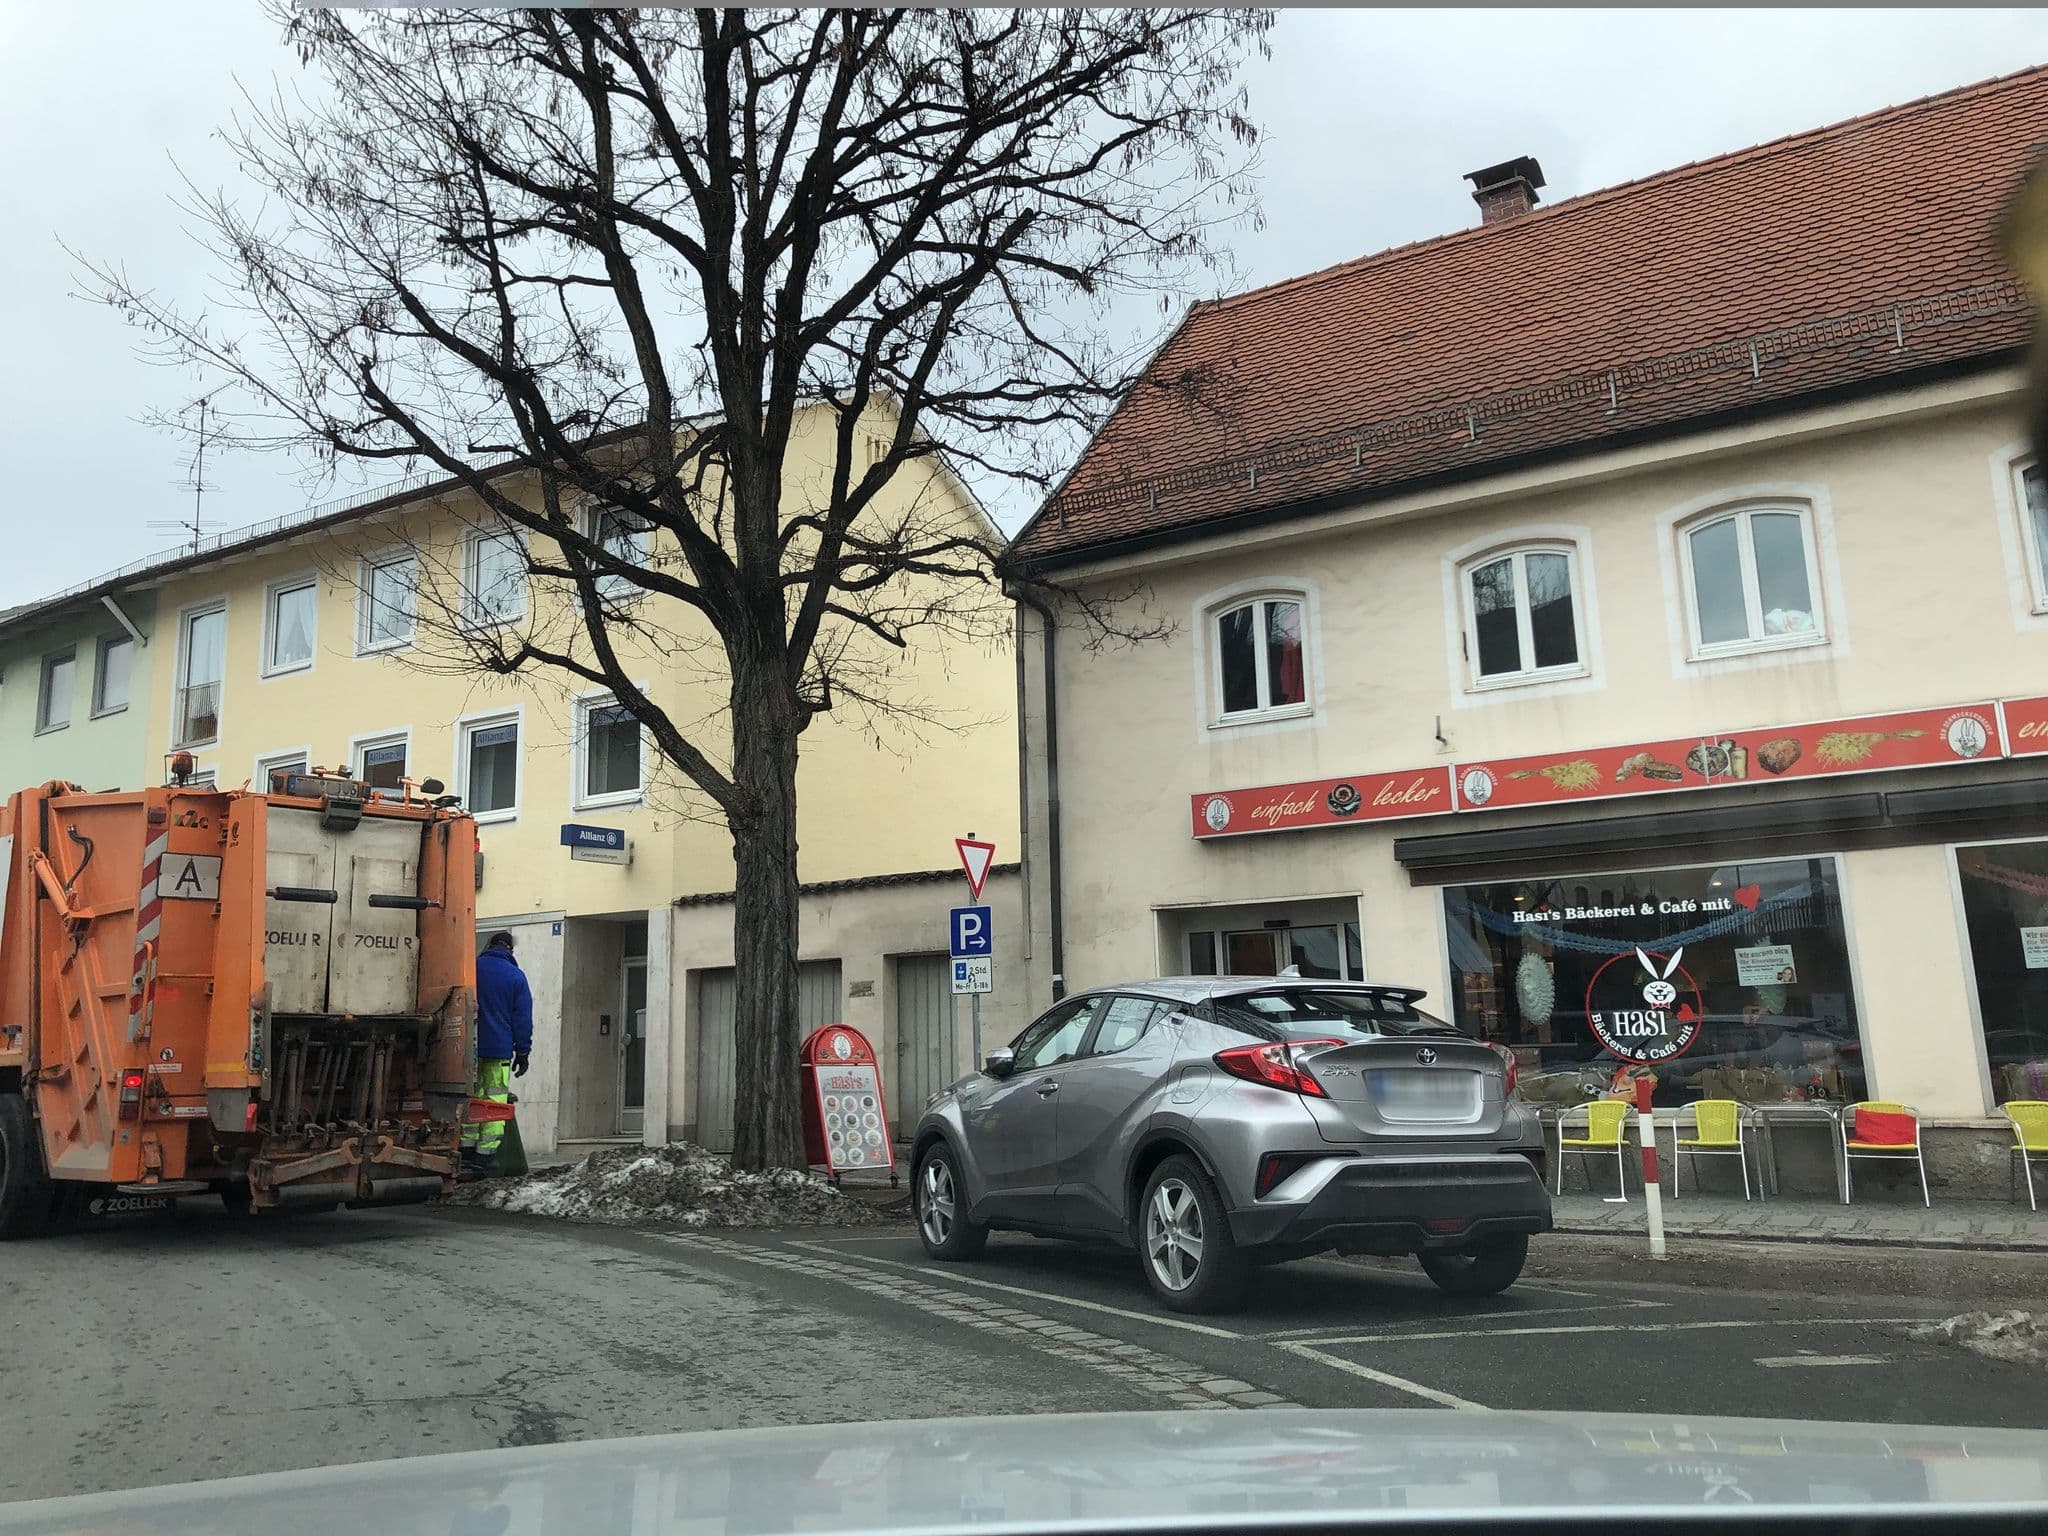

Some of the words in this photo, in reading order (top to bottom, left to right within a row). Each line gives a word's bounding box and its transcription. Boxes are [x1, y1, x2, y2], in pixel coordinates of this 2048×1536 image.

[1251, 790, 1319, 826] einfach
[1372, 777, 1441, 806] lecker
[579, 830, 606, 842] Allianz
[174, 857, 202, 892] A
[1565, 904, 1635, 920] Bäckerei
[1640, 903, 1655, 915] &
[1658, 899, 1697, 914] Café
[1702, 898, 1731, 911] mit
[960, 913, 982, 950] P
[1592, 1012, 1632, 1057] Bäckerei
[1635, 1048, 1647, 1060] &
[1650, 1041, 1678, 1060] Café
[1677, 1024, 1694, 1046] mit
[1613, 1010, 1668, 1036] Hasi
[107, 1198, 168, 1211] ZOELLER
